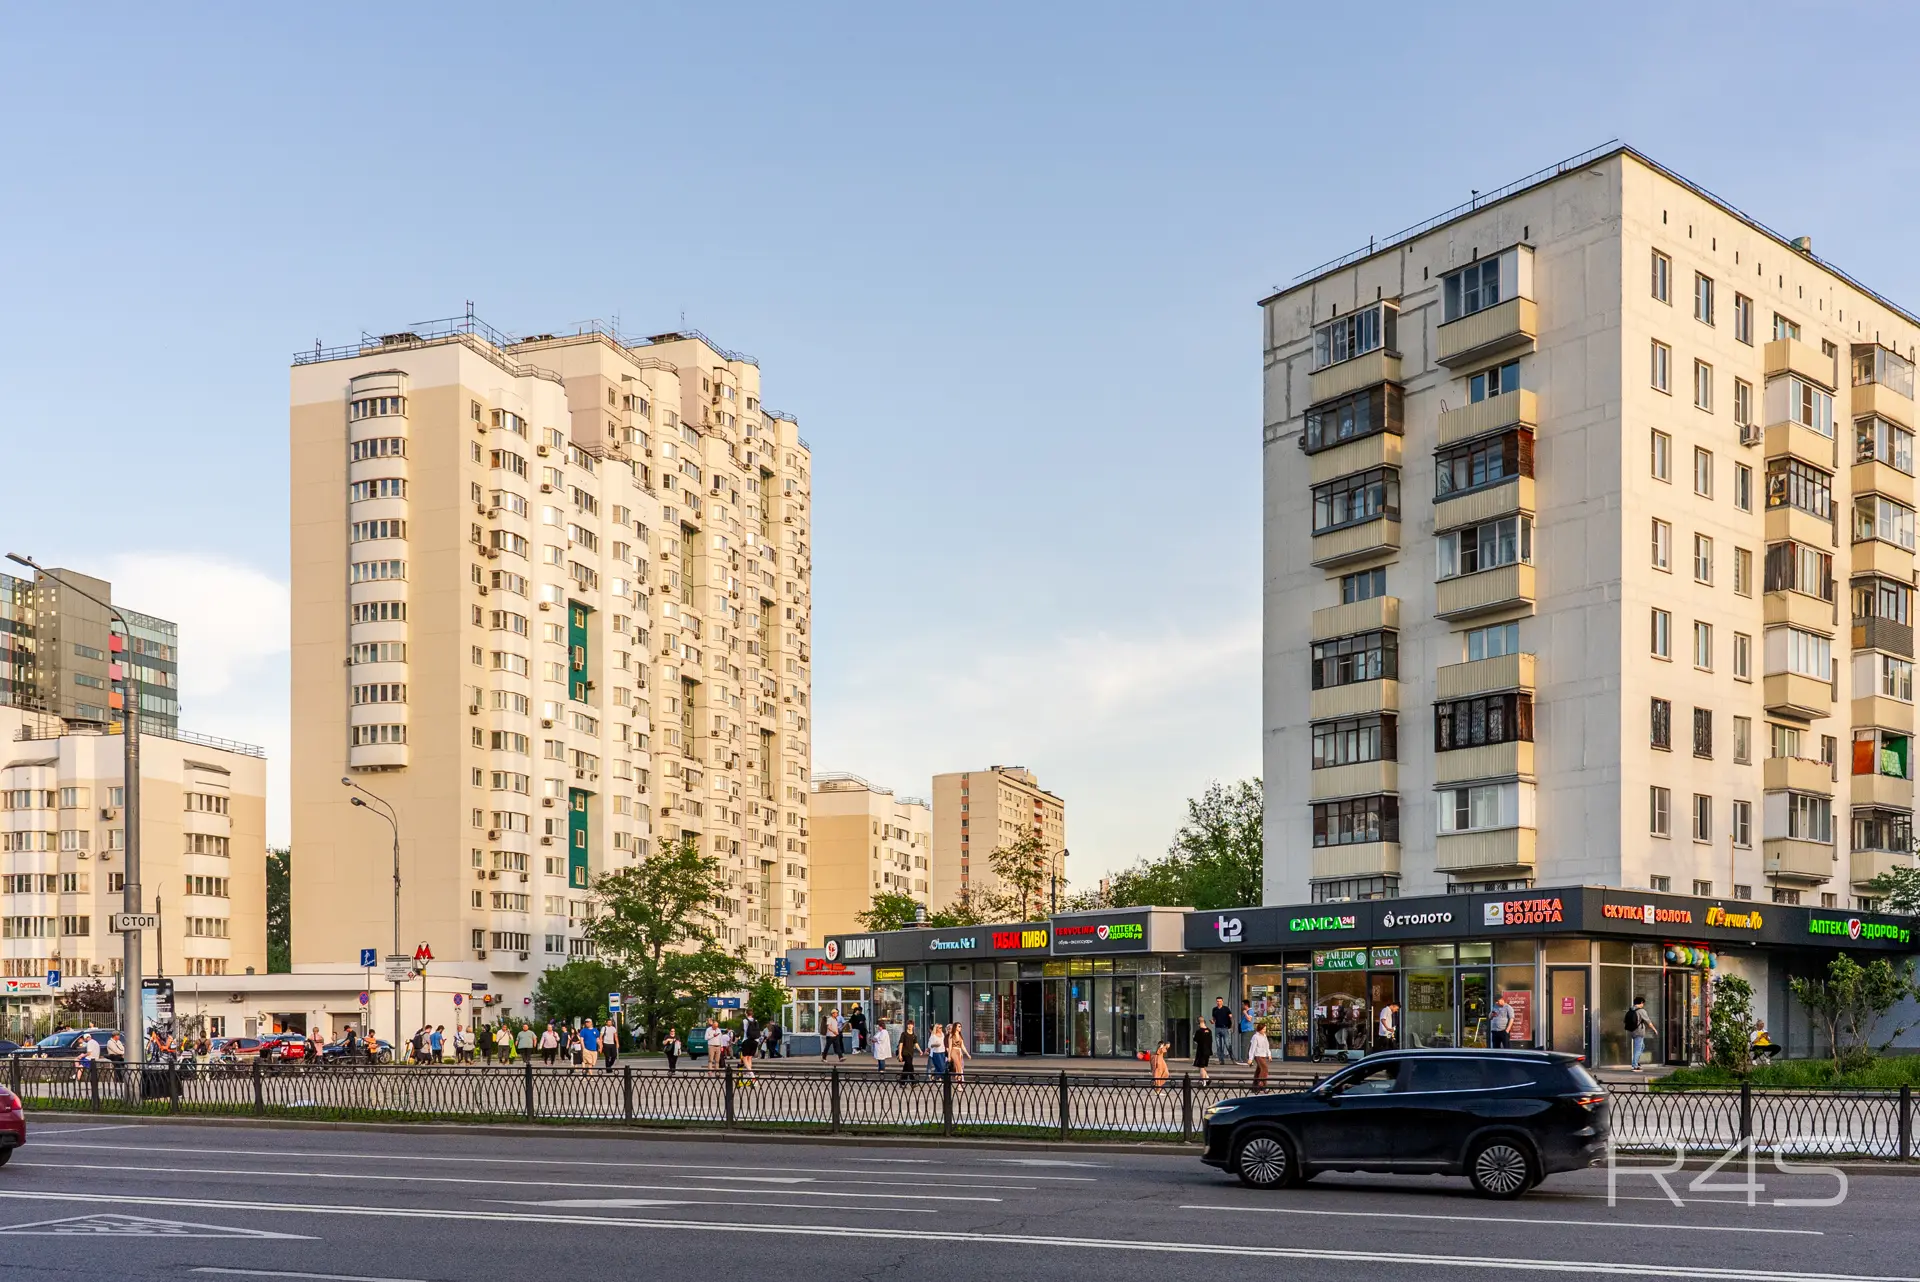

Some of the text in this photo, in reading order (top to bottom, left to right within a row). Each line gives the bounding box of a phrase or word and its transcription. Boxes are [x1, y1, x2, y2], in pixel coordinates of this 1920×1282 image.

[1505, 898, 1563, 913] СКУПКА
[1396, 912, 1452, 925] СТОЛОТО
[1505, 910, 1563, 925] ЗОЛОТА
[1603, 904, 1692, 924] СКУПКА ЗОЛОТА
[122, 917, 154, 926] СТОП
[1109, 924, 1142, 933] АПТЕКА
[1289, 917, 1342, 931] САМСА
[1809, 920, 1849, 935] АПТЕКА
[1214, 916, 1242, 942] t2
[992, 930, 1047, 949] ТАБАК ПИВО
[845, 939, 876, 958] ШАУРМА
[1371, 949, 1398, 958] САМСА
[1326, 951, 1355, 961] ТАНДЫР
[1328, 960, 1353, 968] САМСА
